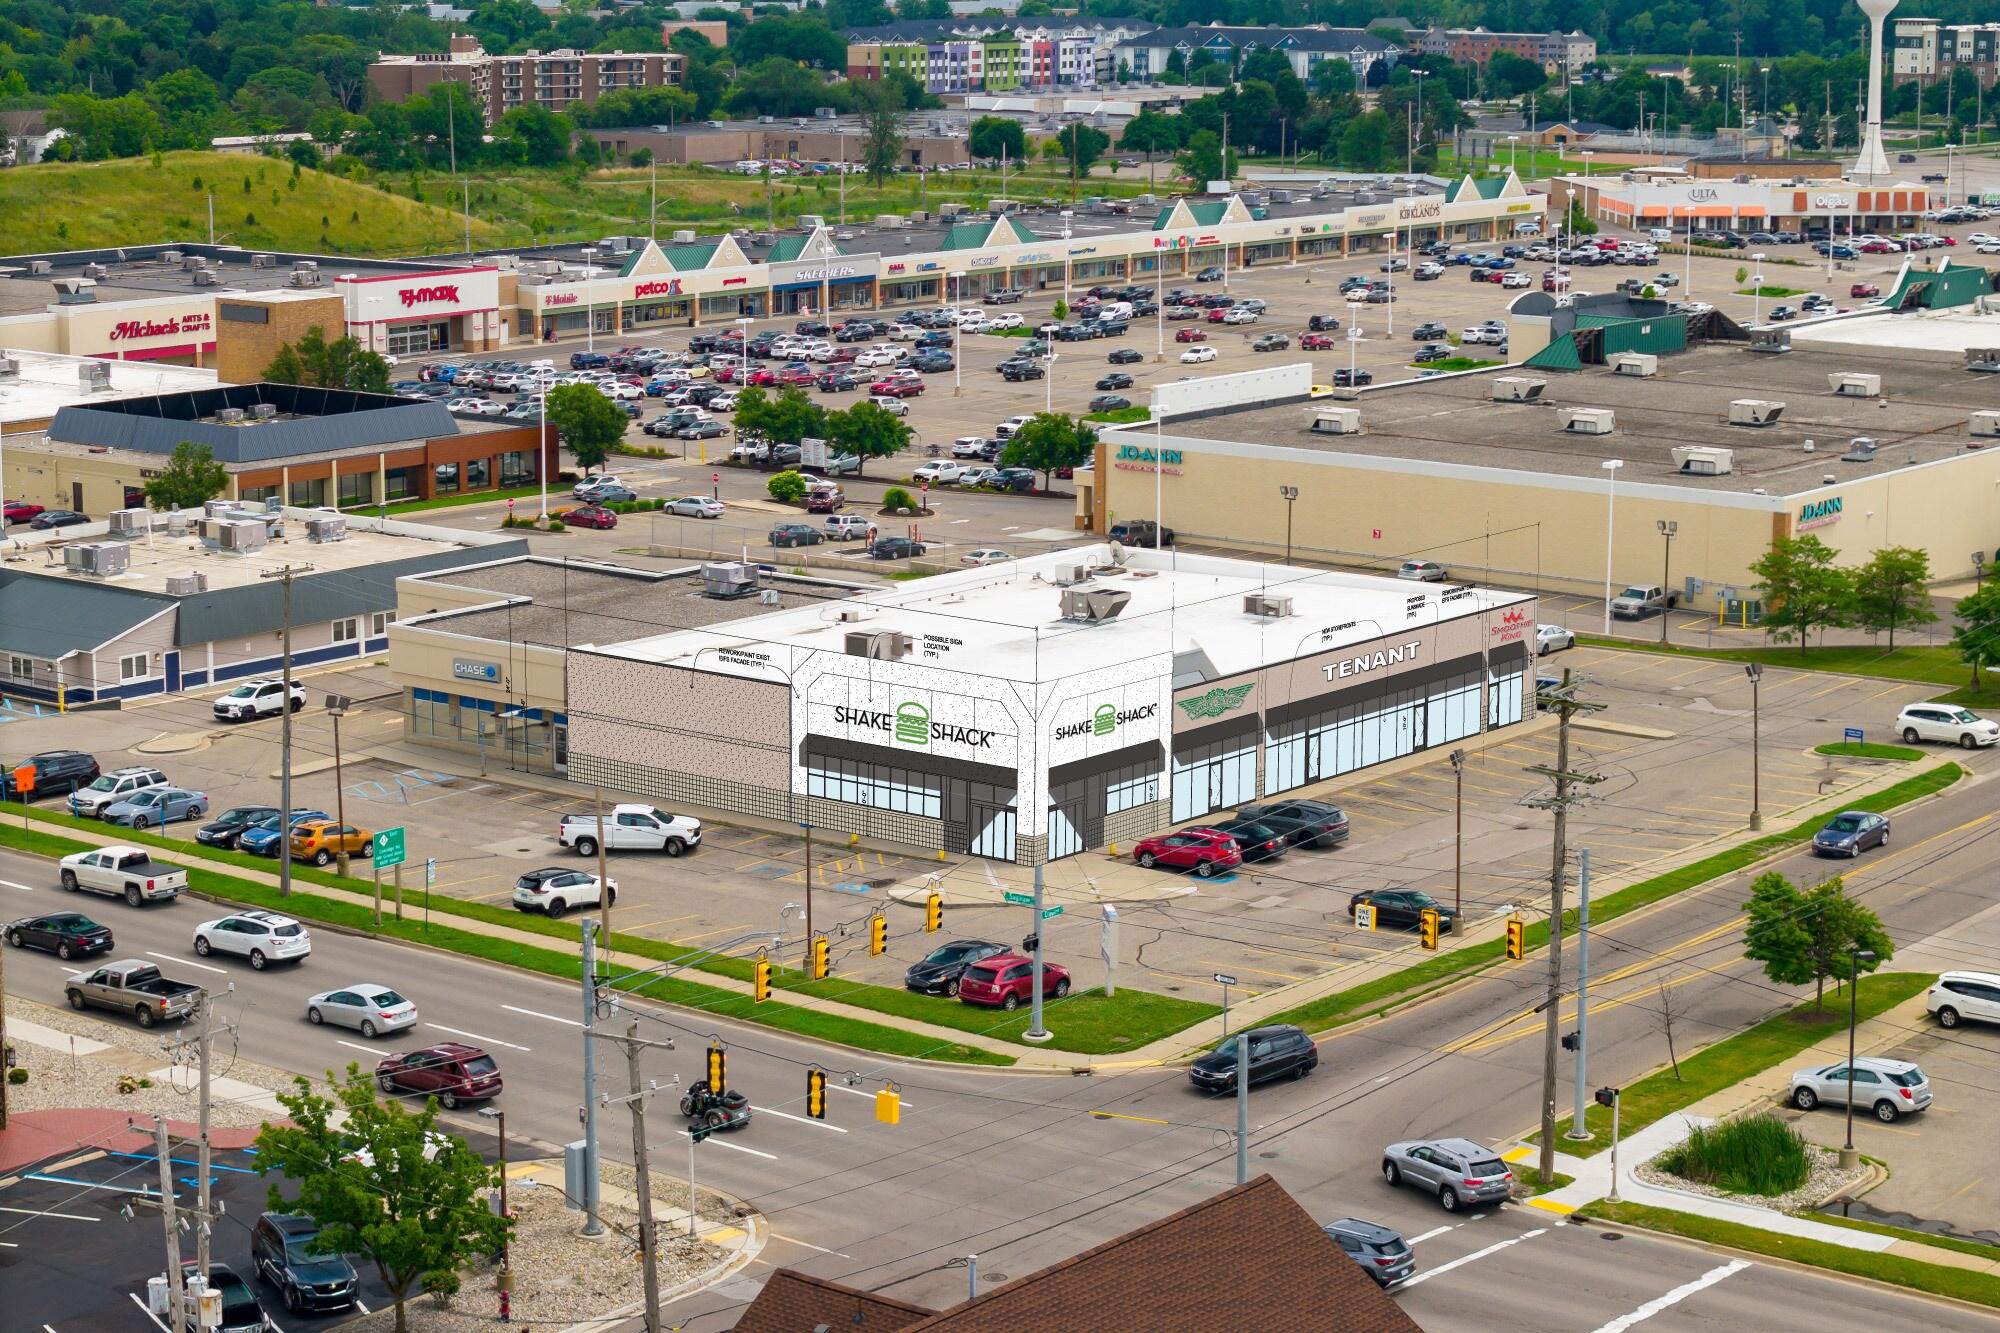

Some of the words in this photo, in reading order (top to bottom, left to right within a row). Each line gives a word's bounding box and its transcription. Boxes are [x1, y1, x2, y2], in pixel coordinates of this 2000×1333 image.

[1692, 189, 1717, 198] ULTA
[795, 266, 855, 280] SKECHERS
[635, 282, 668, 298] petco
[182, 314, 202, 323] ARTS
[203, 313, 210, 321] &
[110, 318, 180, 340] Michaels
[182, 323, 210, 332] CRAFTS
[455, 663, 485, 676] CHASE
